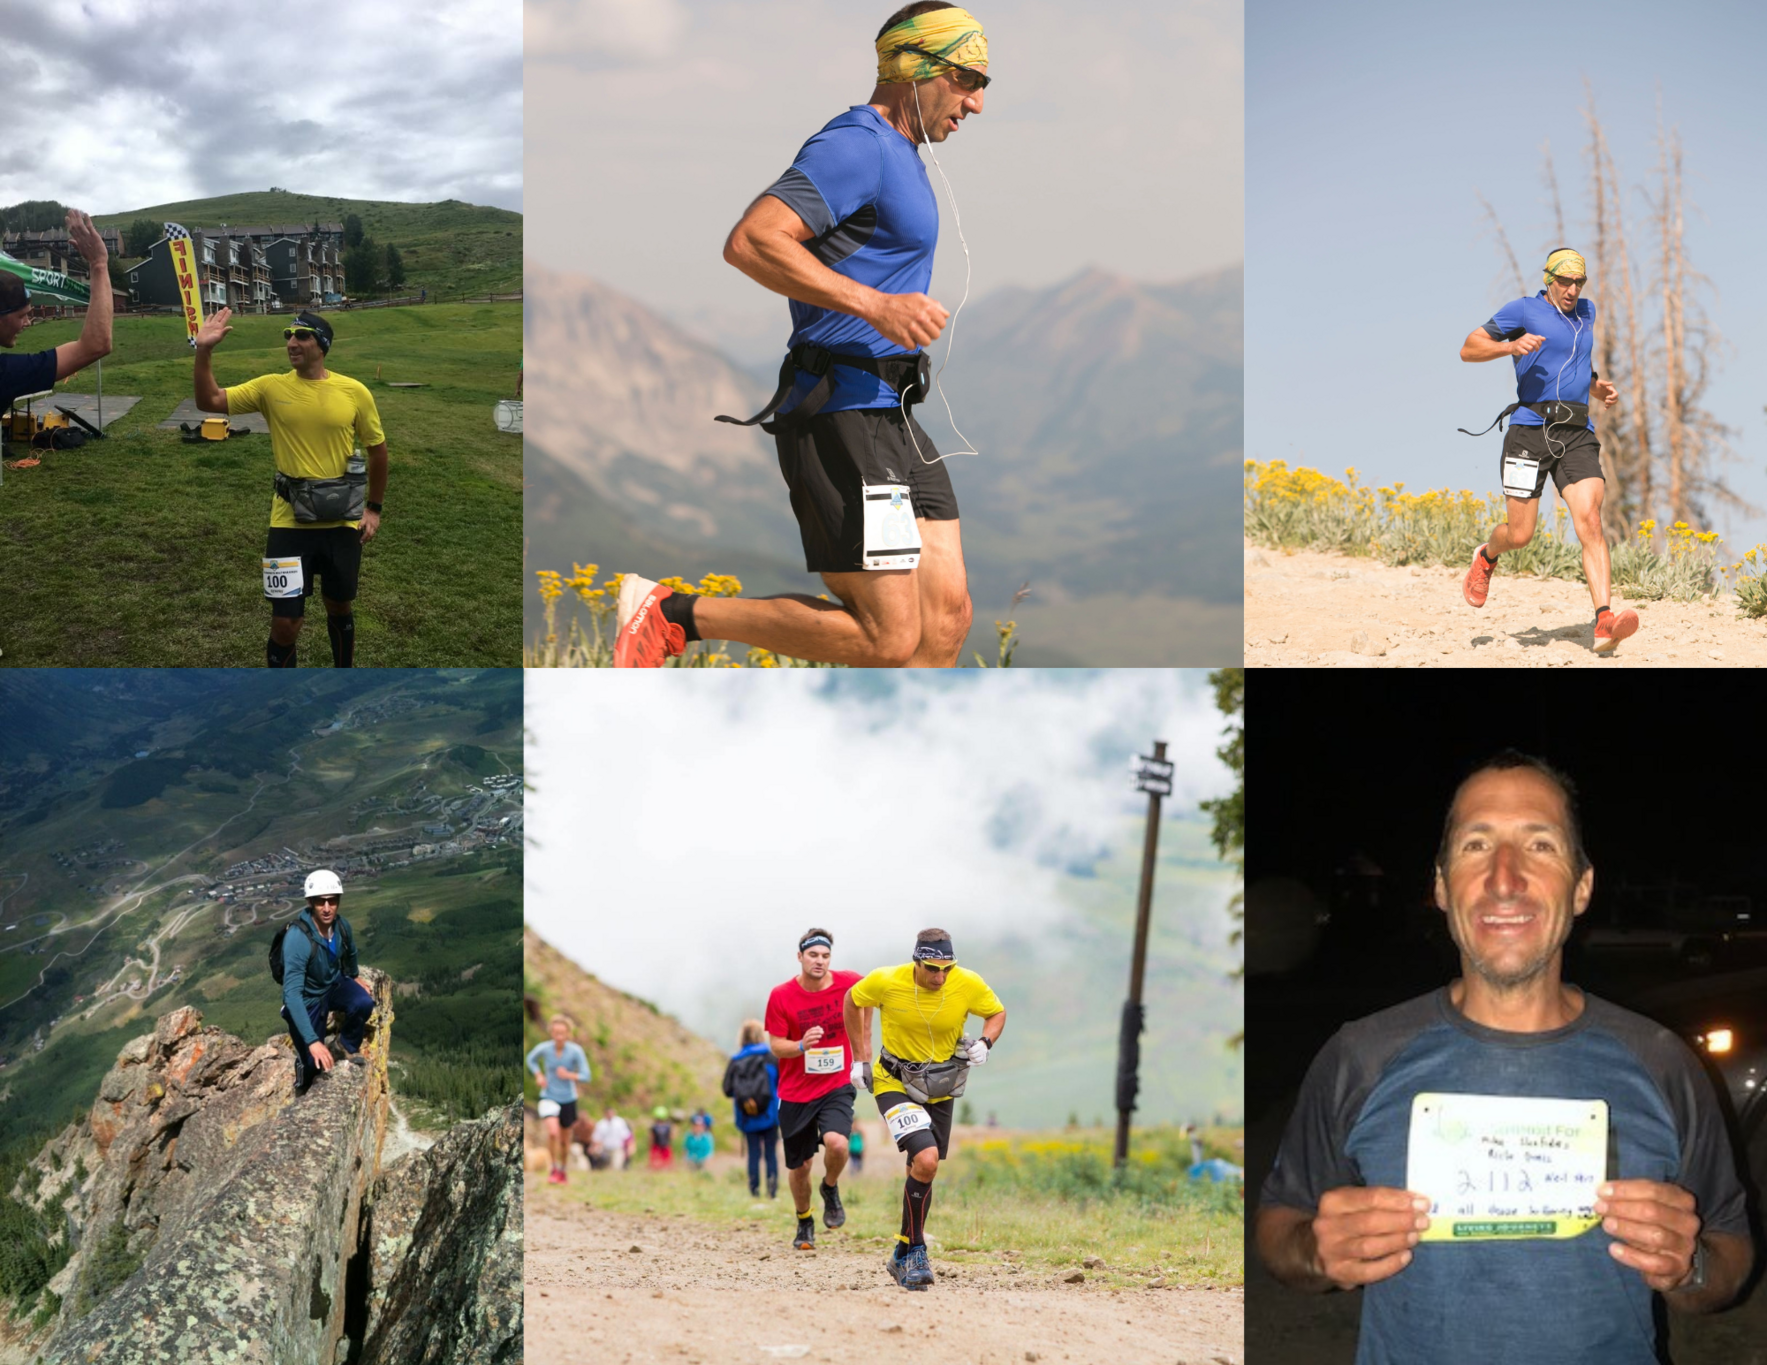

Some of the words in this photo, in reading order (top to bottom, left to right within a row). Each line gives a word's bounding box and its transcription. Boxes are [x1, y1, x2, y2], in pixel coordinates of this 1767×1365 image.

[31, 268, 66, 289] SPORT
[881, 511, 914, 548] 63
[267, 575, 288, 588] 100
[818, 1058, 835, 1067] 159
[898, 1114, 919, 1129] 100
